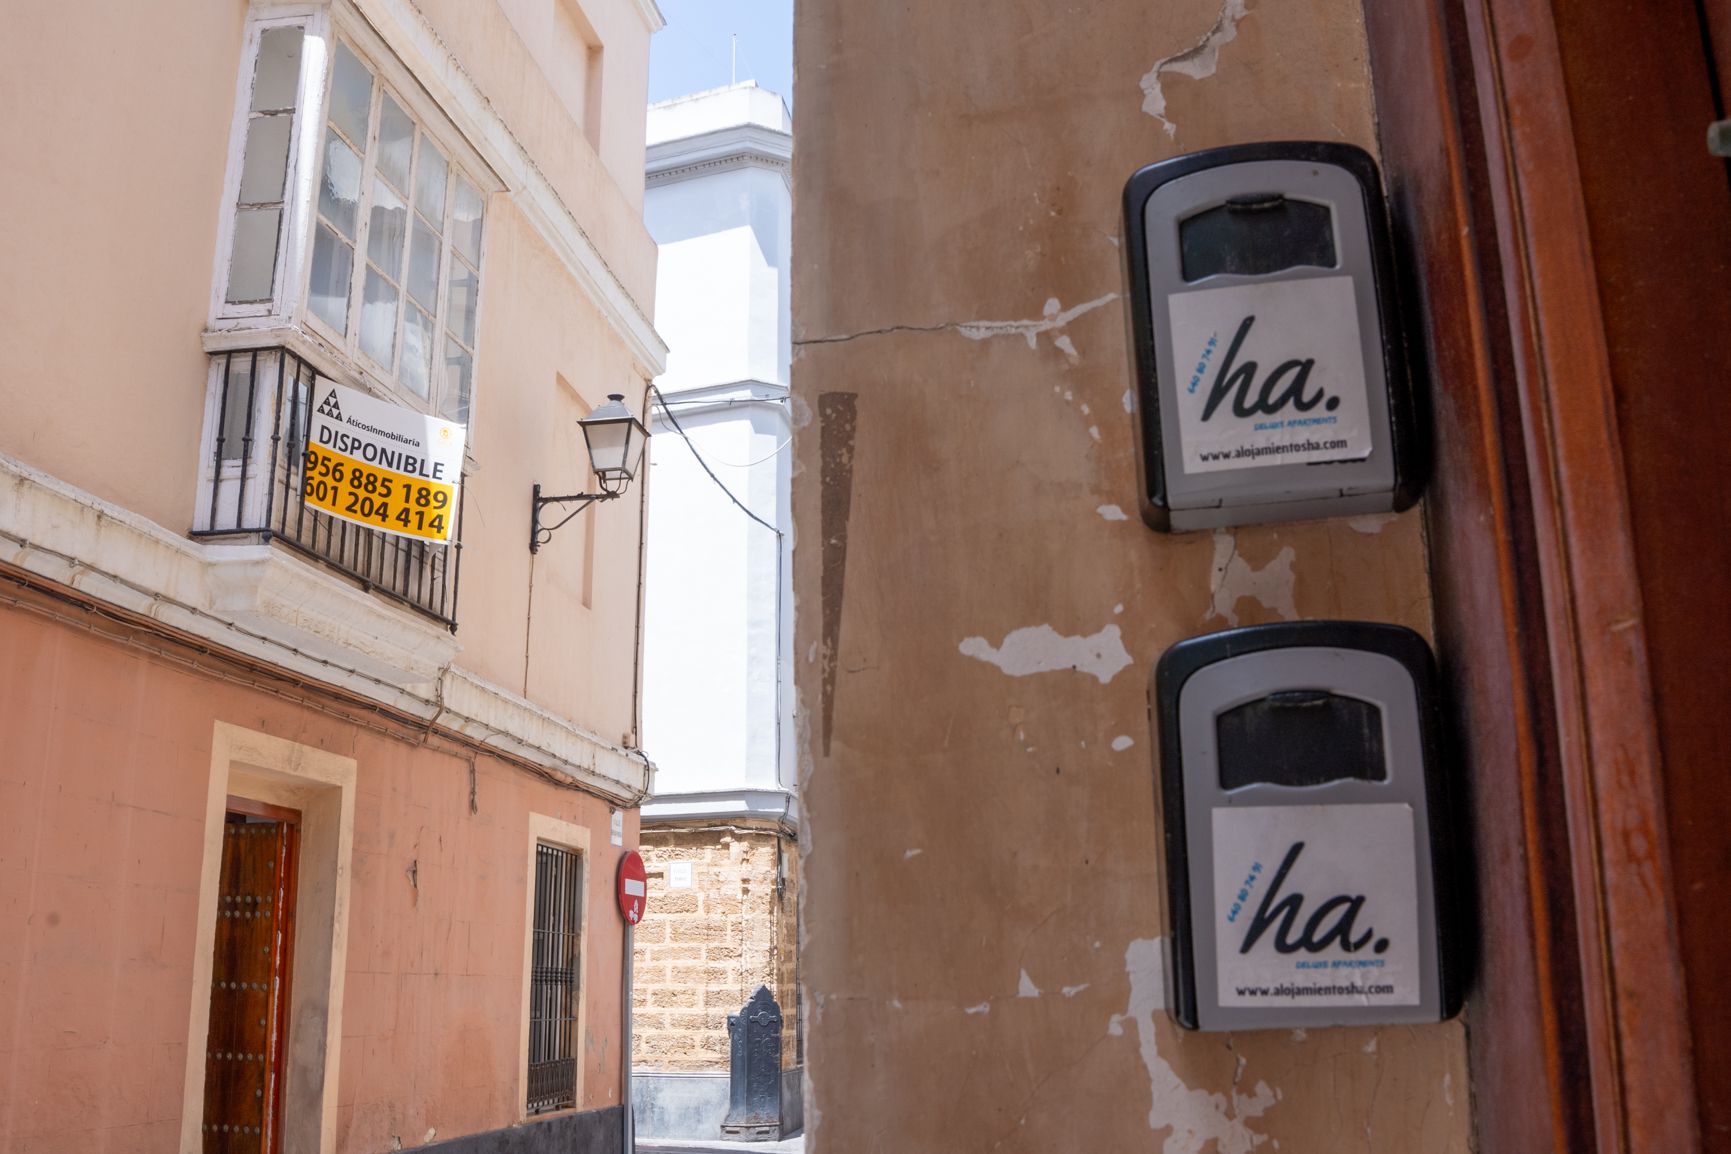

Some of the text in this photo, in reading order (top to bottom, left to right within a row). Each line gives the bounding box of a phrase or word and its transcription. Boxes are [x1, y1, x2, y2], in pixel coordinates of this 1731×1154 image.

[1201, 315, 1340, 422] ha.
[318, 424, 444, 480] DISPONIBLE
[346, 415, 420, 448] ÁticosInmobiliaria
[1200, 438, 1348, 462] www.alojamientosha.com
[305, 476, 444, 534] 601 204 414
[306, 450, 448, 510] 956 885 189
[1239, 841, 1390, 954] ha.
